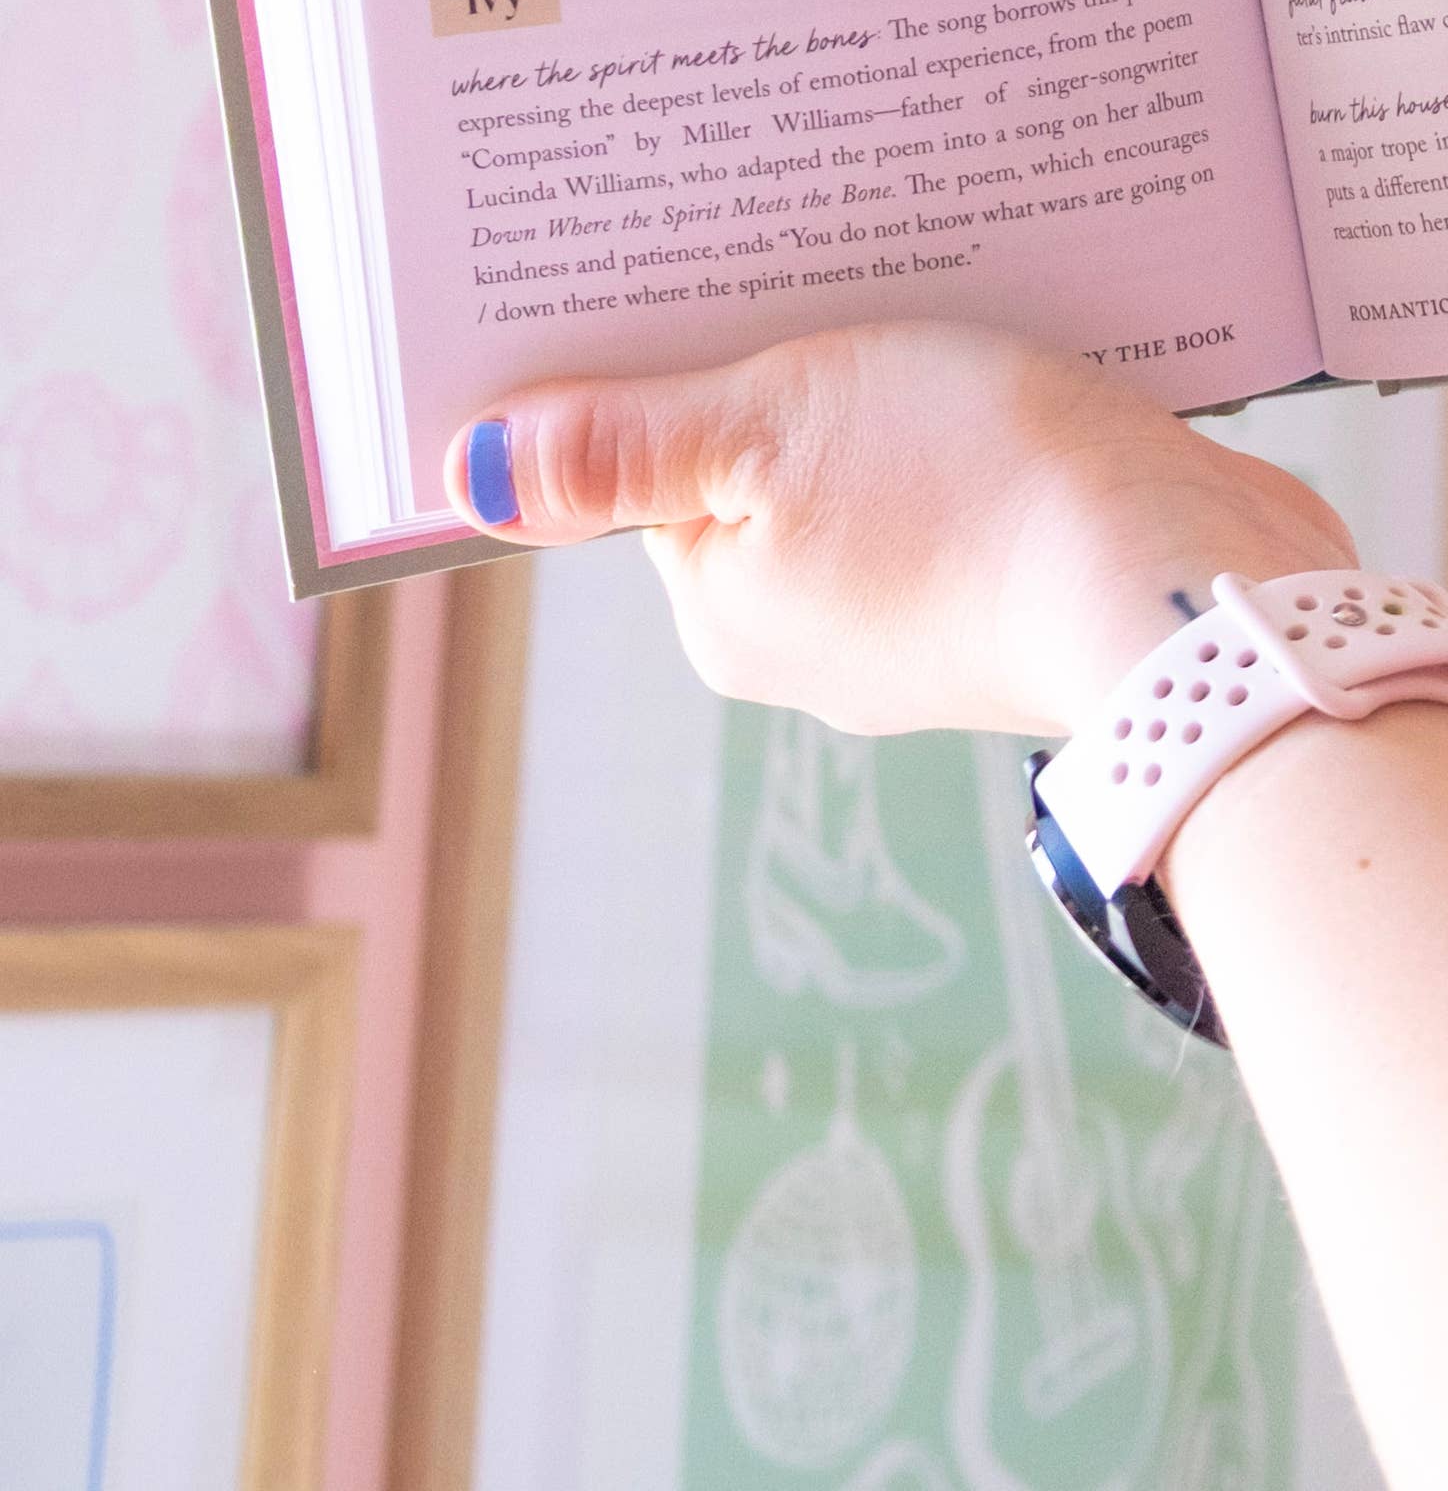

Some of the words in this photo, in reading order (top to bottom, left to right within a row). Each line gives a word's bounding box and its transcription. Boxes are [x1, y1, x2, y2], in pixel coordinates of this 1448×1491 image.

[452, 69, 528, 97] where
[535, 59, 582, 88] the
[588, 50, 665, 89] spirit
[671, 41, 746, 70] meets
[752, 33, 799, 62] the
[887, 17, 929, 40] The
[937, 14, 987, 34] song
[1349, 96, 1390, 123] this
[471, 227, 536, 247] Down
[549, 216, 612, 238] Where
[621, 209, 652, 230] the
[662, 202, 721, 232] Spirit
[730, 196, 791, 217] Meets
[801, 188, 832, 209] the
[841, 183, 896, 204] Bone.
[904, 172, 946, 195] The
[957, 167, 1023, 196] poem,
[1030, 147, 1094, 176] which
[1104, 129, 1209, 163] encourages
[495, 301, 555, 322] down
[562, 293, 617, 314] there
[624, 285, 690, 306] where
[697, 277, 732, 298] the
[739, 270, 794, 299] spirit
[802, 266, 865, 286] meets
[872, 256, 906, 278] the
[1082, 349, 1107, 365] Y
[1115, 340, 1166, 362] THE
[1175, 324, 1235, 352] BOOK
